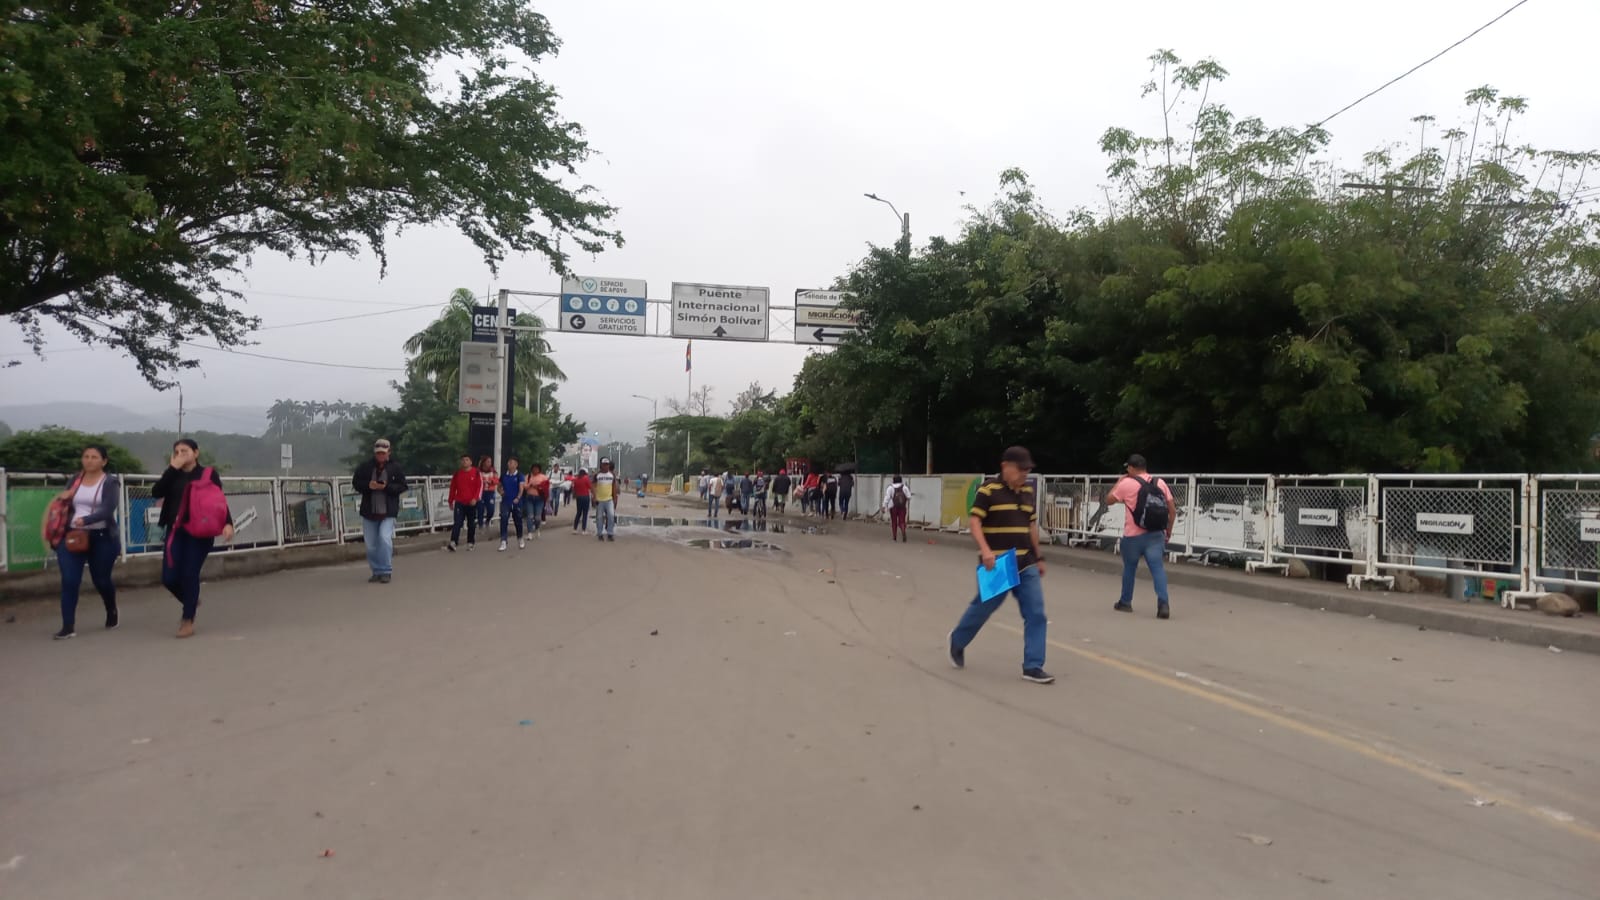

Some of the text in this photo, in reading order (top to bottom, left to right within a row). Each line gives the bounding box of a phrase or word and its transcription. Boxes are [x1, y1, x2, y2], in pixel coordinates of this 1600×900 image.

[600, 280, 624, 288] ESPACIO
[699, 288, 742, 299] Puente
[678, 300, 760, 313] Internacional
[599, 317, 636, 325] SERVICIOS
[677, 312, 762, 326] Simón Bolívar
[598, 324, 638, 332] GRATUITOS
[1419, 519, 1460, 528] MIGRACIÓN
